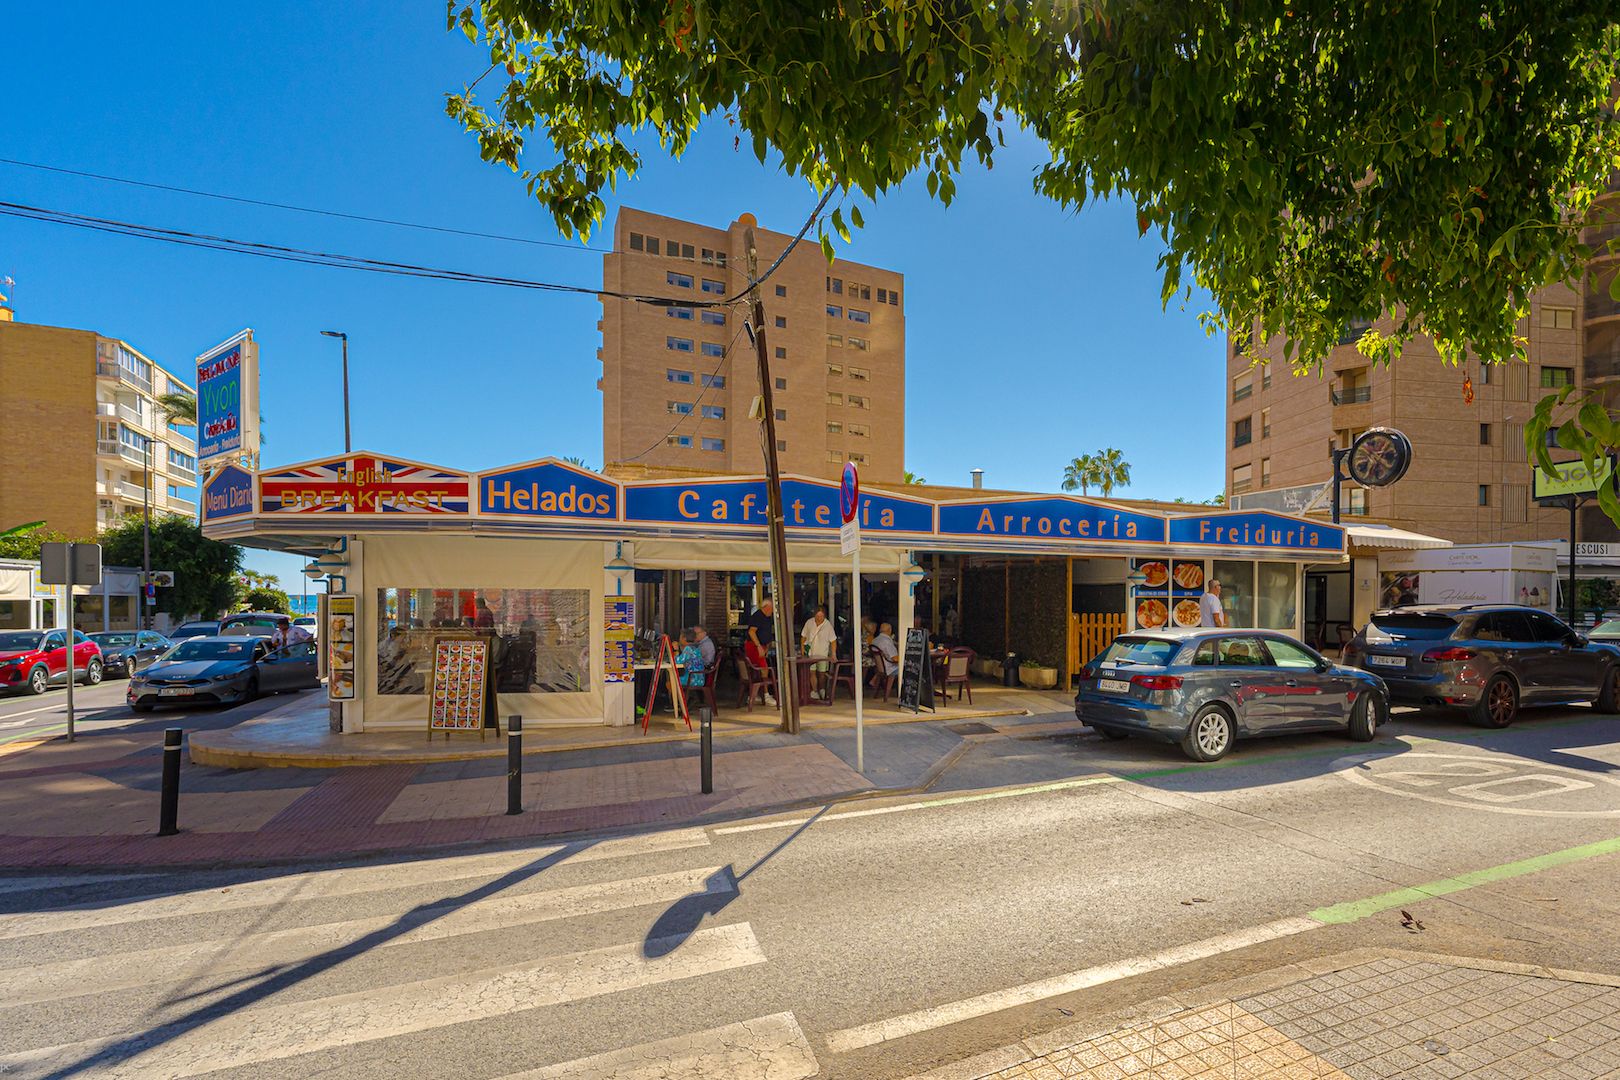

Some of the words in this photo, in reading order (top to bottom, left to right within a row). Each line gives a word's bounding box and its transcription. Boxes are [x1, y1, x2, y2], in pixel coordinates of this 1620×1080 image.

[203, 380, 238, 417] Yvon
[337, 466, 393, 487] English
[206, 487, 228, 512] Menú
[280, 489, 449, 508] BREAKFAST
[487, 479, 610, 515] Helados
[678, 489, 895, 527] Cafteía
[976, 507, 1138, 538] Arrocería
[1199, 520, 1319, 546] Freiduría
